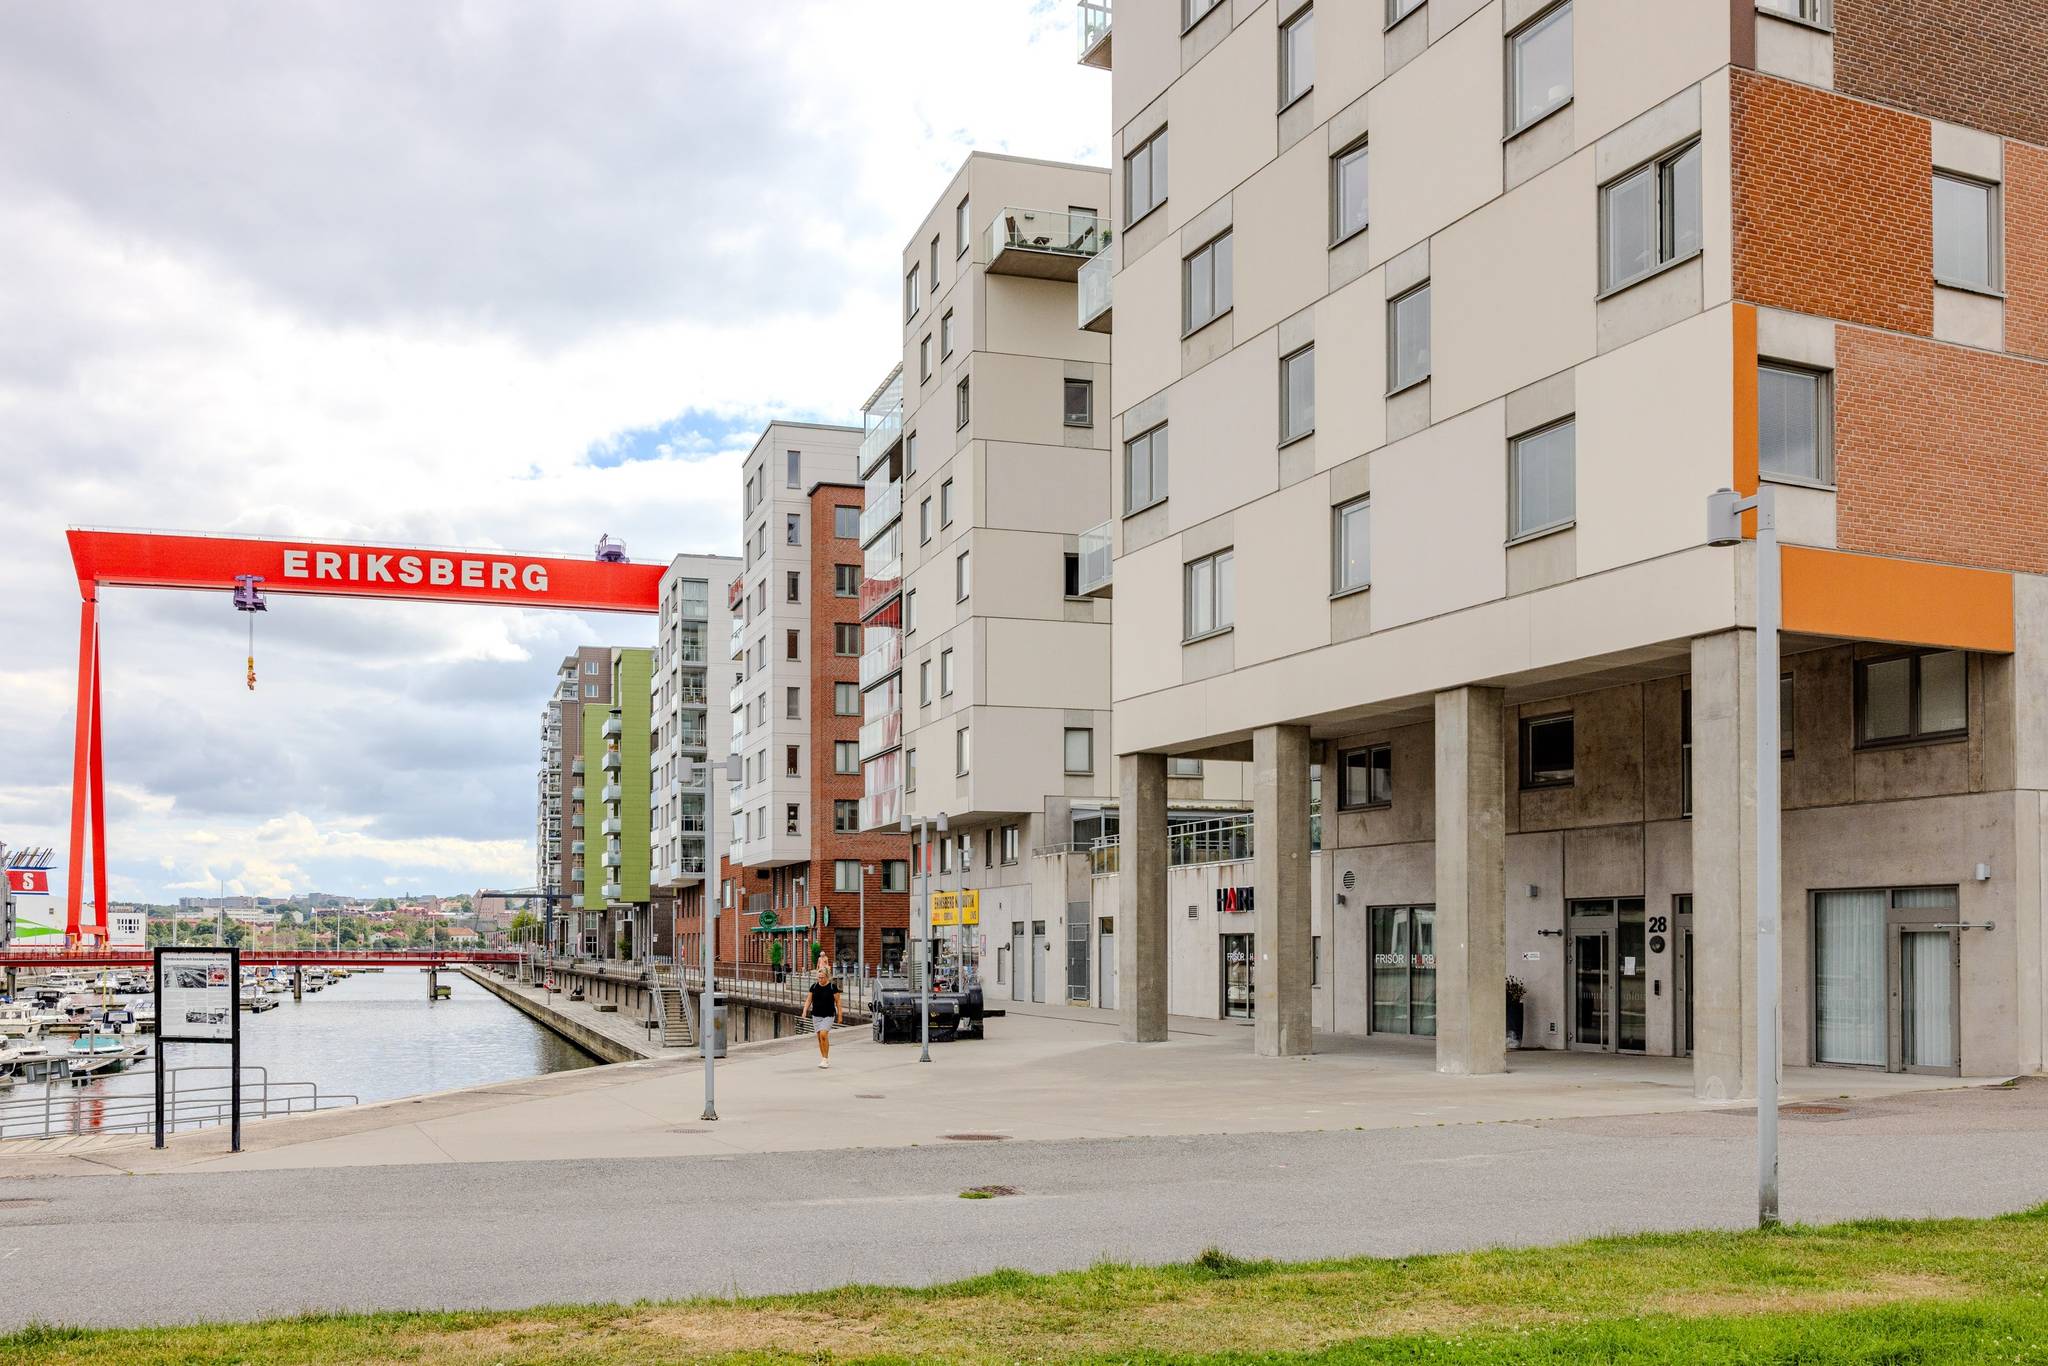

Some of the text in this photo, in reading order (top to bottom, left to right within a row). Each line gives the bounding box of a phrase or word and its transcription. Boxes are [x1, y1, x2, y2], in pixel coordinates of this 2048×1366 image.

[283, 549, 549, 592] ERIKSBERG
[23, 872, 34, 890] S
[1648, 916, 1667, 933] 28
[1375, 952, 1405, 964] FRISÖR
